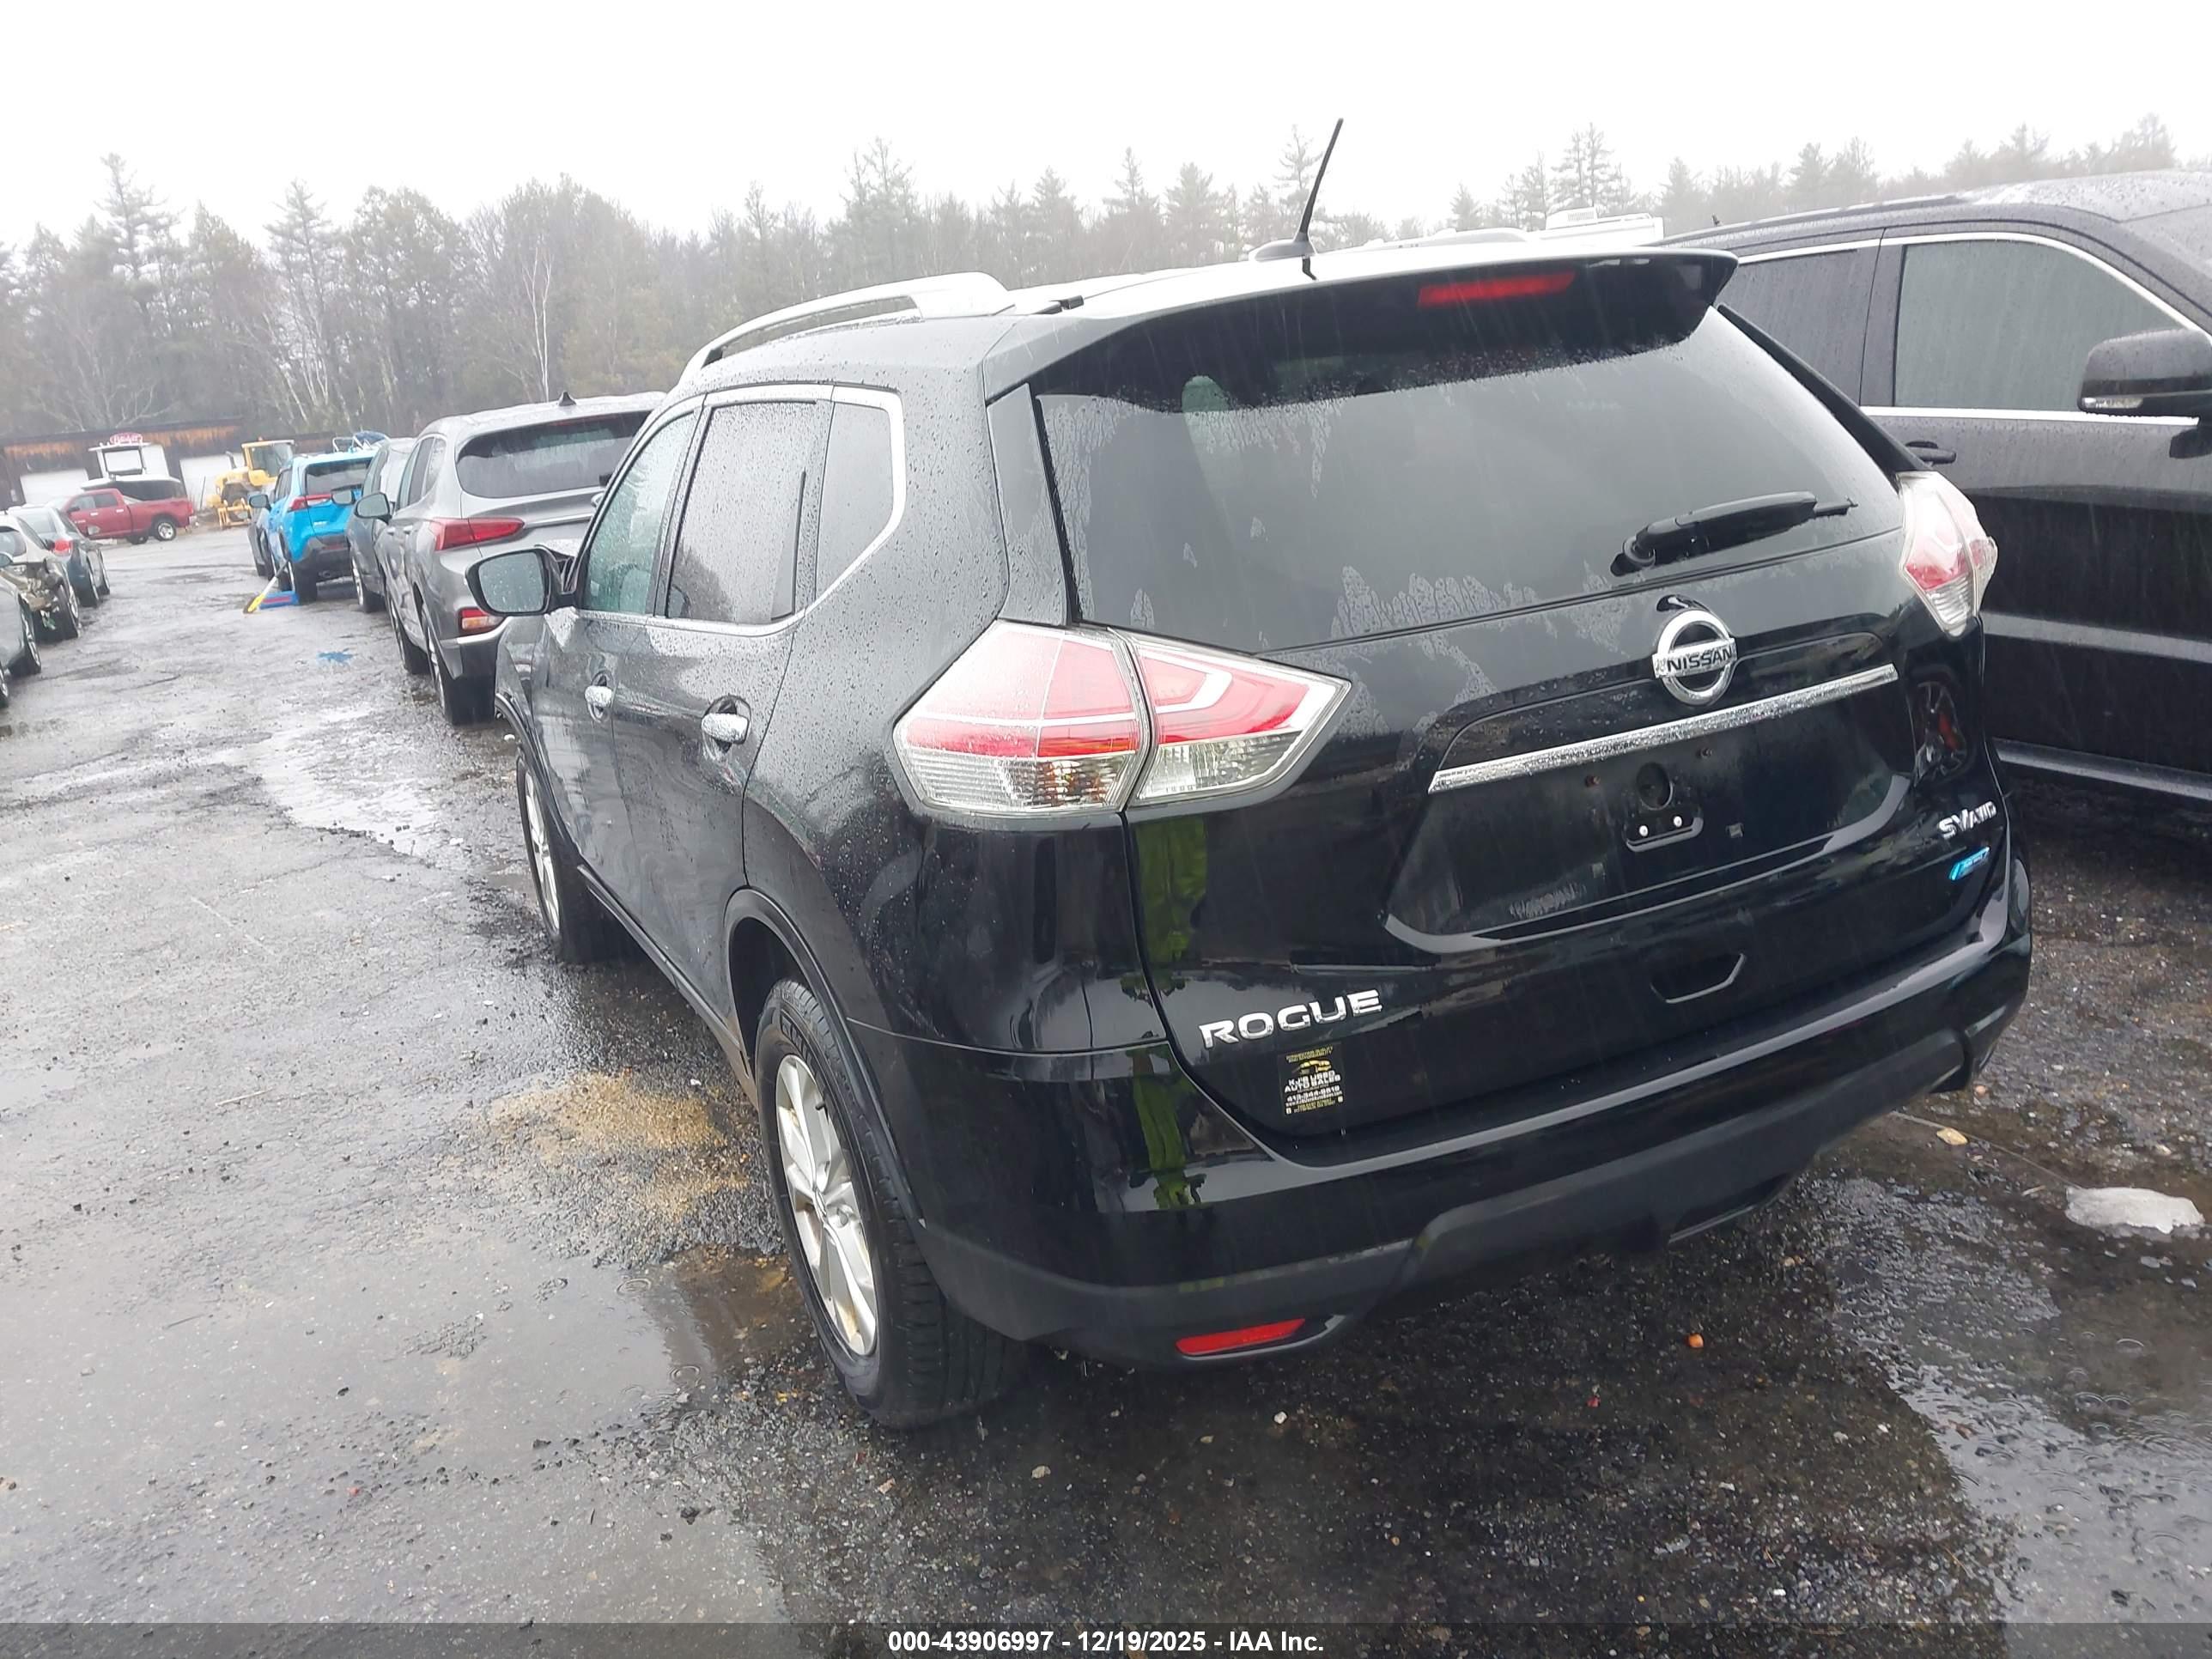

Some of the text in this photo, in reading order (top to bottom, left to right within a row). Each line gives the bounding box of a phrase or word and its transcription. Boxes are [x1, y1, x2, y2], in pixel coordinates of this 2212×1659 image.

[1667, 646, 1733, 672] NISSAN
[1198, 989, 1383, 1048] ROGUE
[1285, 1080, 1310, 1092] AUTO
[1310, 1073, 1341, 1087] SALES
